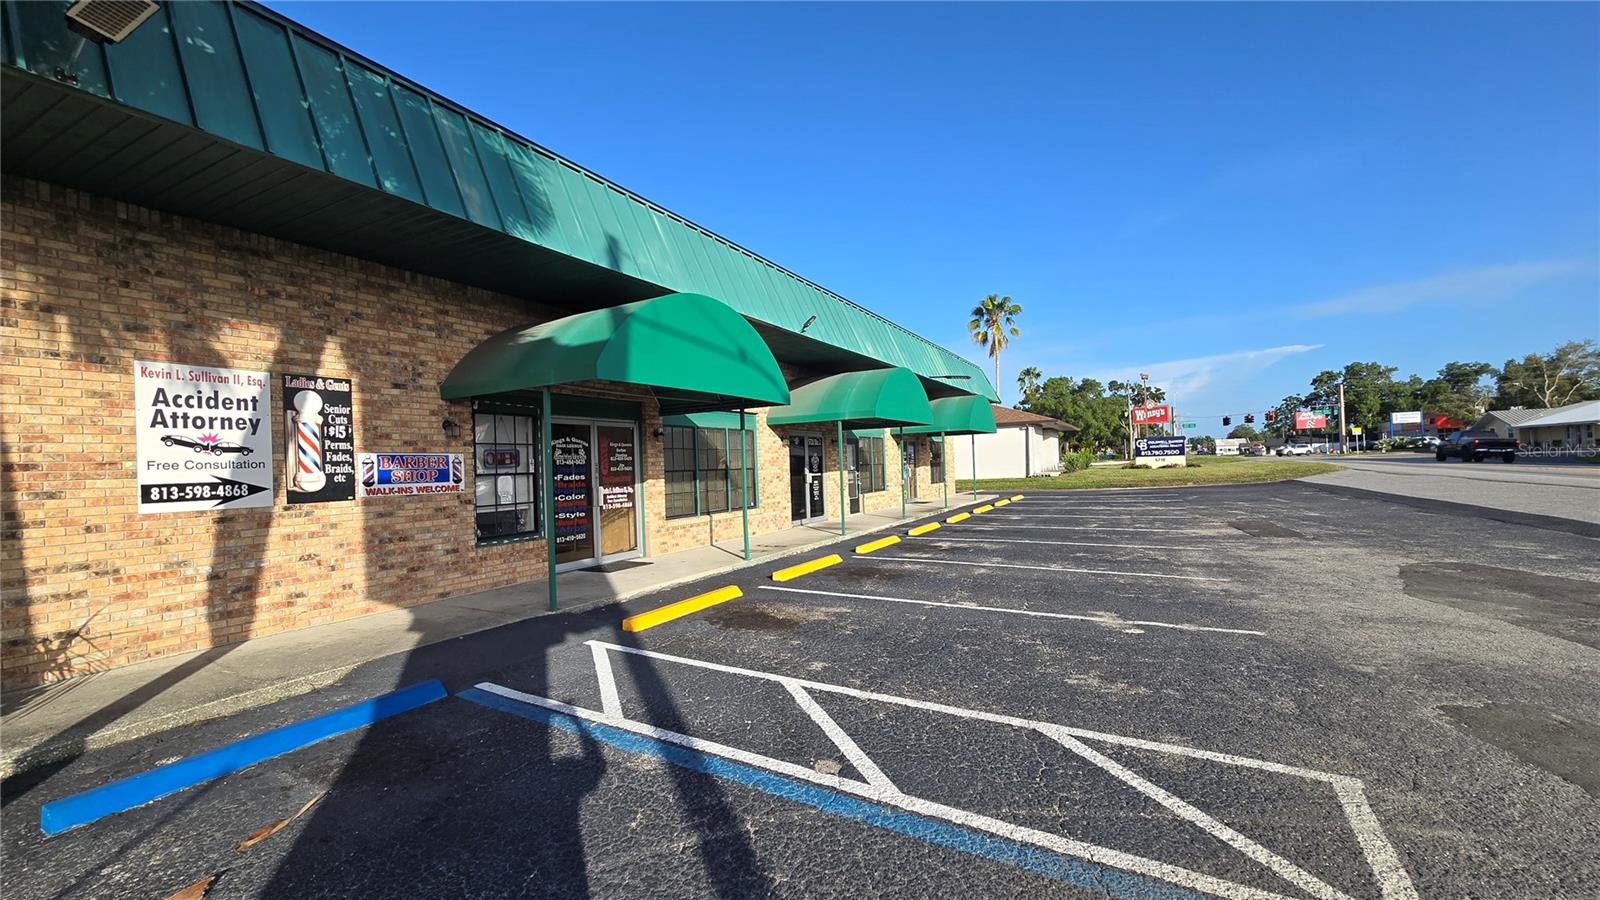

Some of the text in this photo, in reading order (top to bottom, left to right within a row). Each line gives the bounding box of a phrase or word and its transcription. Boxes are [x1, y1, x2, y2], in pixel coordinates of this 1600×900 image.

[140, 366, 172, 380] Kevin
[176, 369, 185, 381] L.
[188, 370, 230, 384] Sullivan
[247, 375, 266, 389] Esq.
[285, 375, 350, 392] Ladies & Gents
[151, 387, 259, 412] Accident
[324, 403, 351, 415] Senior
[150, 408, 261, 436] Attorney
[328, 414, 348, 425] Cuts
[324, 439, 353, 452] Perms,
[326, 451, 353, 463] Fades,
[379, 456, 448, 470] BARBER
[146, 459, 266, 471] Free Consultation
[325, 463, 354, 475] Braids,
[333, 474, 347, 483] etc
[390, 470, 439, 483] SHOP
[150, 484, 249, 501] 813-598-4868
[365, 484, 461, 497] WALK-INS WELCOME
[558, 494, 586, 502] Color
[558, 511, 586, 519] Style
